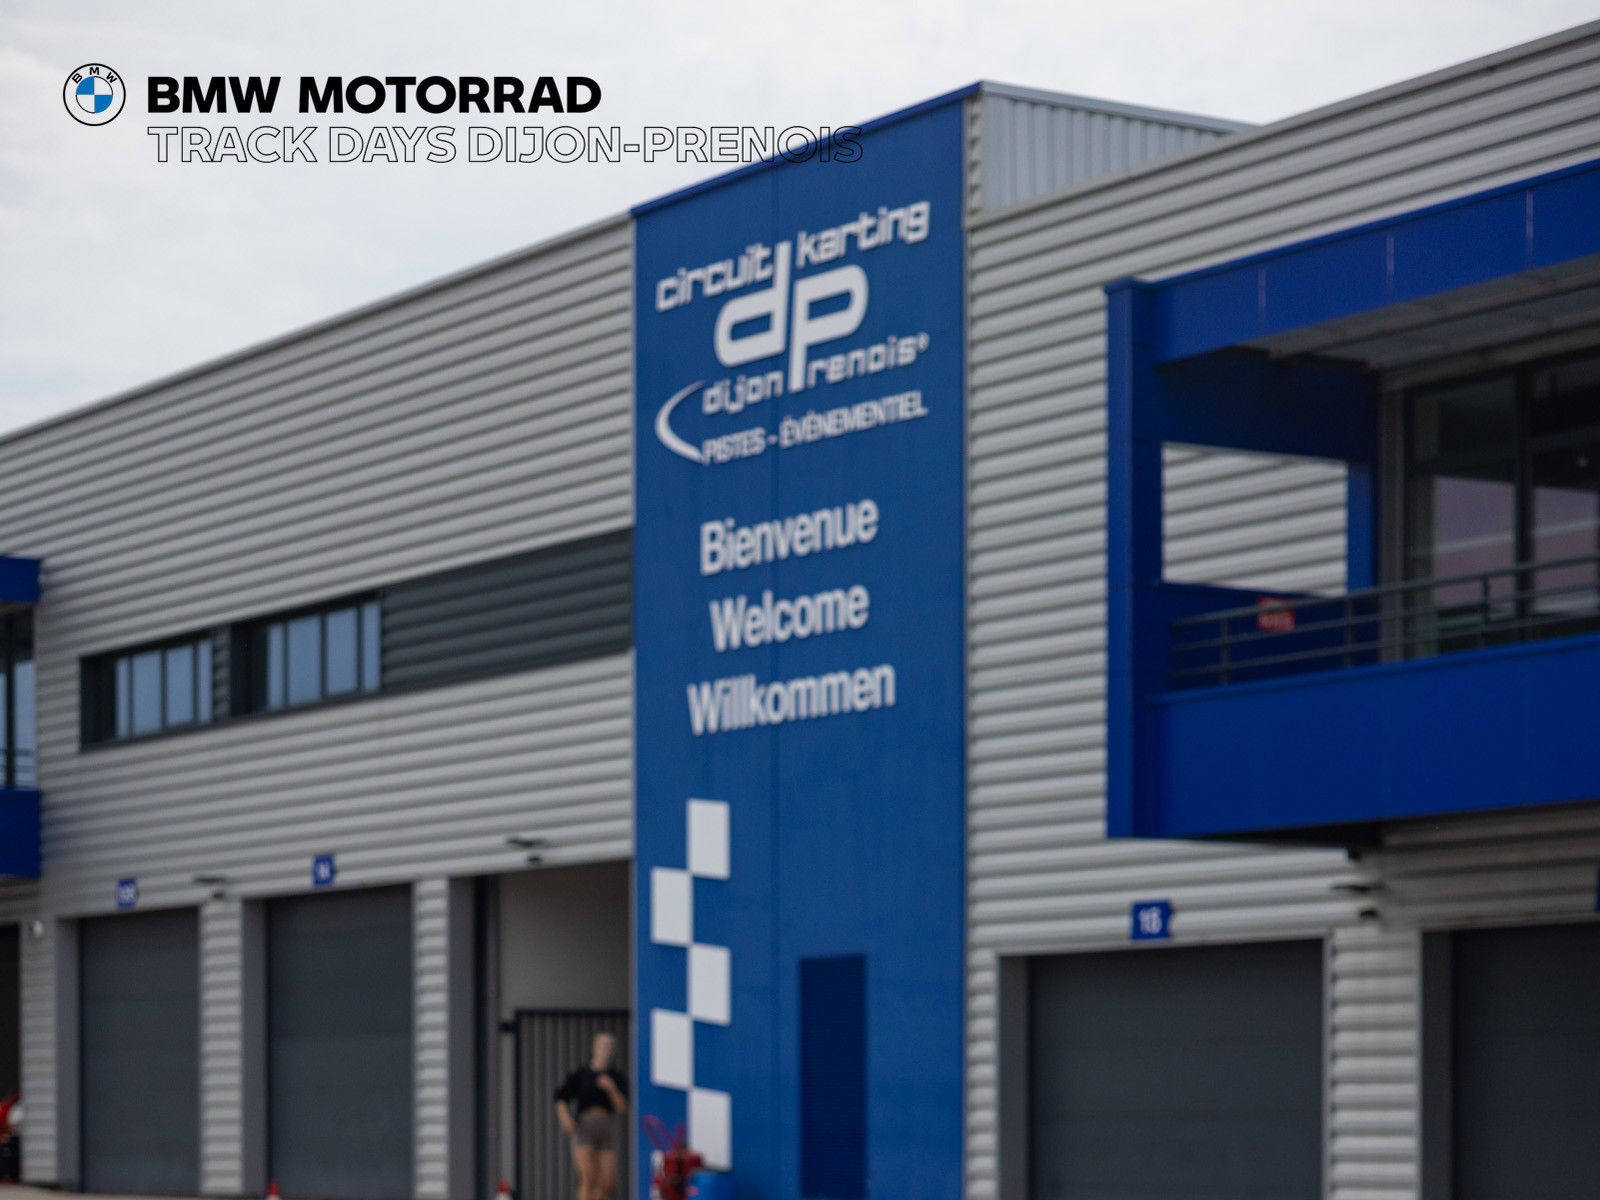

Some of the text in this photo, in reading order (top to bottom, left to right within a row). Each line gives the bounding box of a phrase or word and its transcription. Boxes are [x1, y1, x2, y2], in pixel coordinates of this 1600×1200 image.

[656, 201, 930, 312] circuit karting
[702, 370, 784, 415] dijon
[702, 427, 766, 466] PISTES
[700, 499, 879, 576] Bienvenue
[709, 584, 870, 653] Welcome
[687, 664, 896, 736] Willkommen
